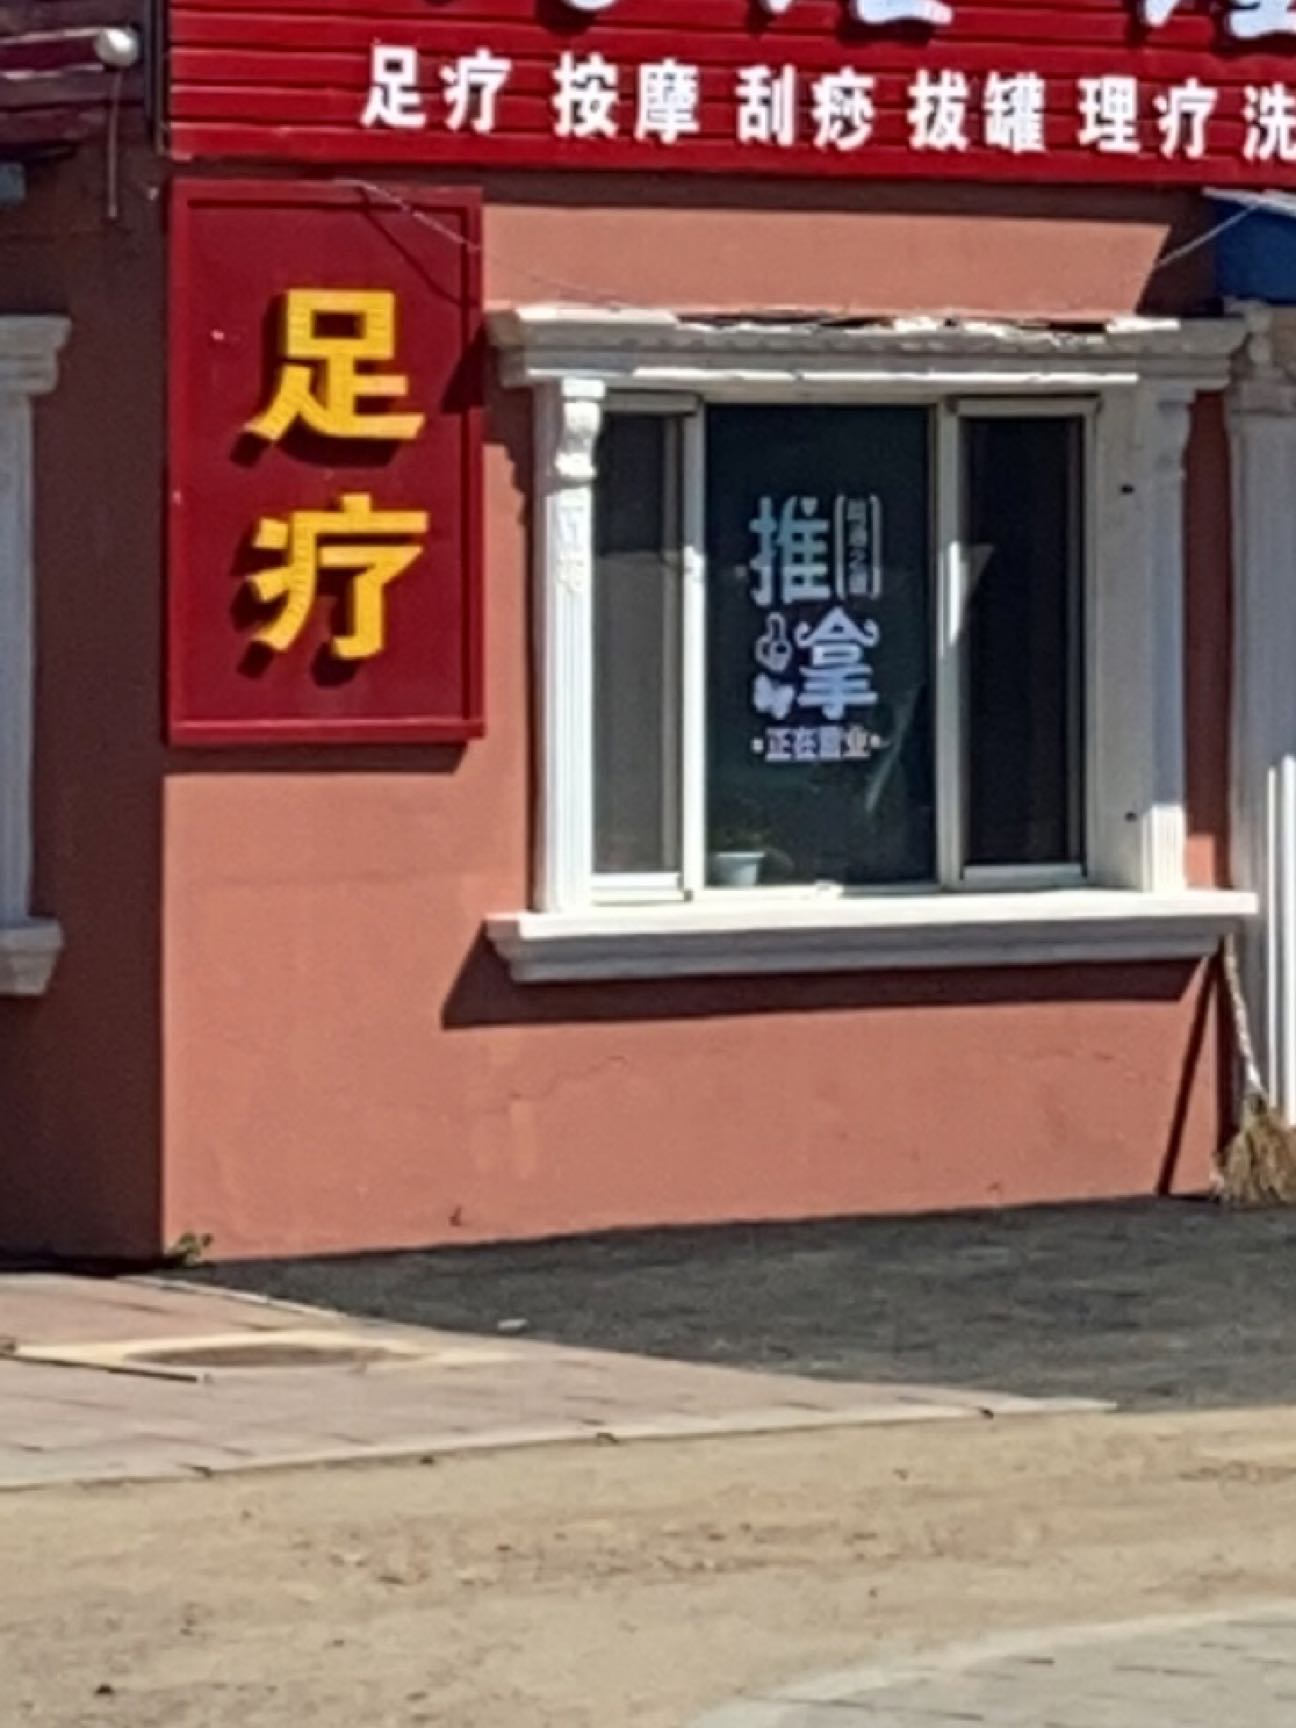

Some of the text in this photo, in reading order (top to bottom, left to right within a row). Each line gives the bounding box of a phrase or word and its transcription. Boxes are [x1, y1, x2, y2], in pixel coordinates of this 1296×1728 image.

[359, 42, 513, 133] 足疗
[551, 49, 700, 144] 按摩
[733, 63, 876, 149] 刮痧
[905, 67, 1046, 153] 拔罐
[1076, 74, 1219, 159] 理疗
[245, 289, 429, 659] 足疗
